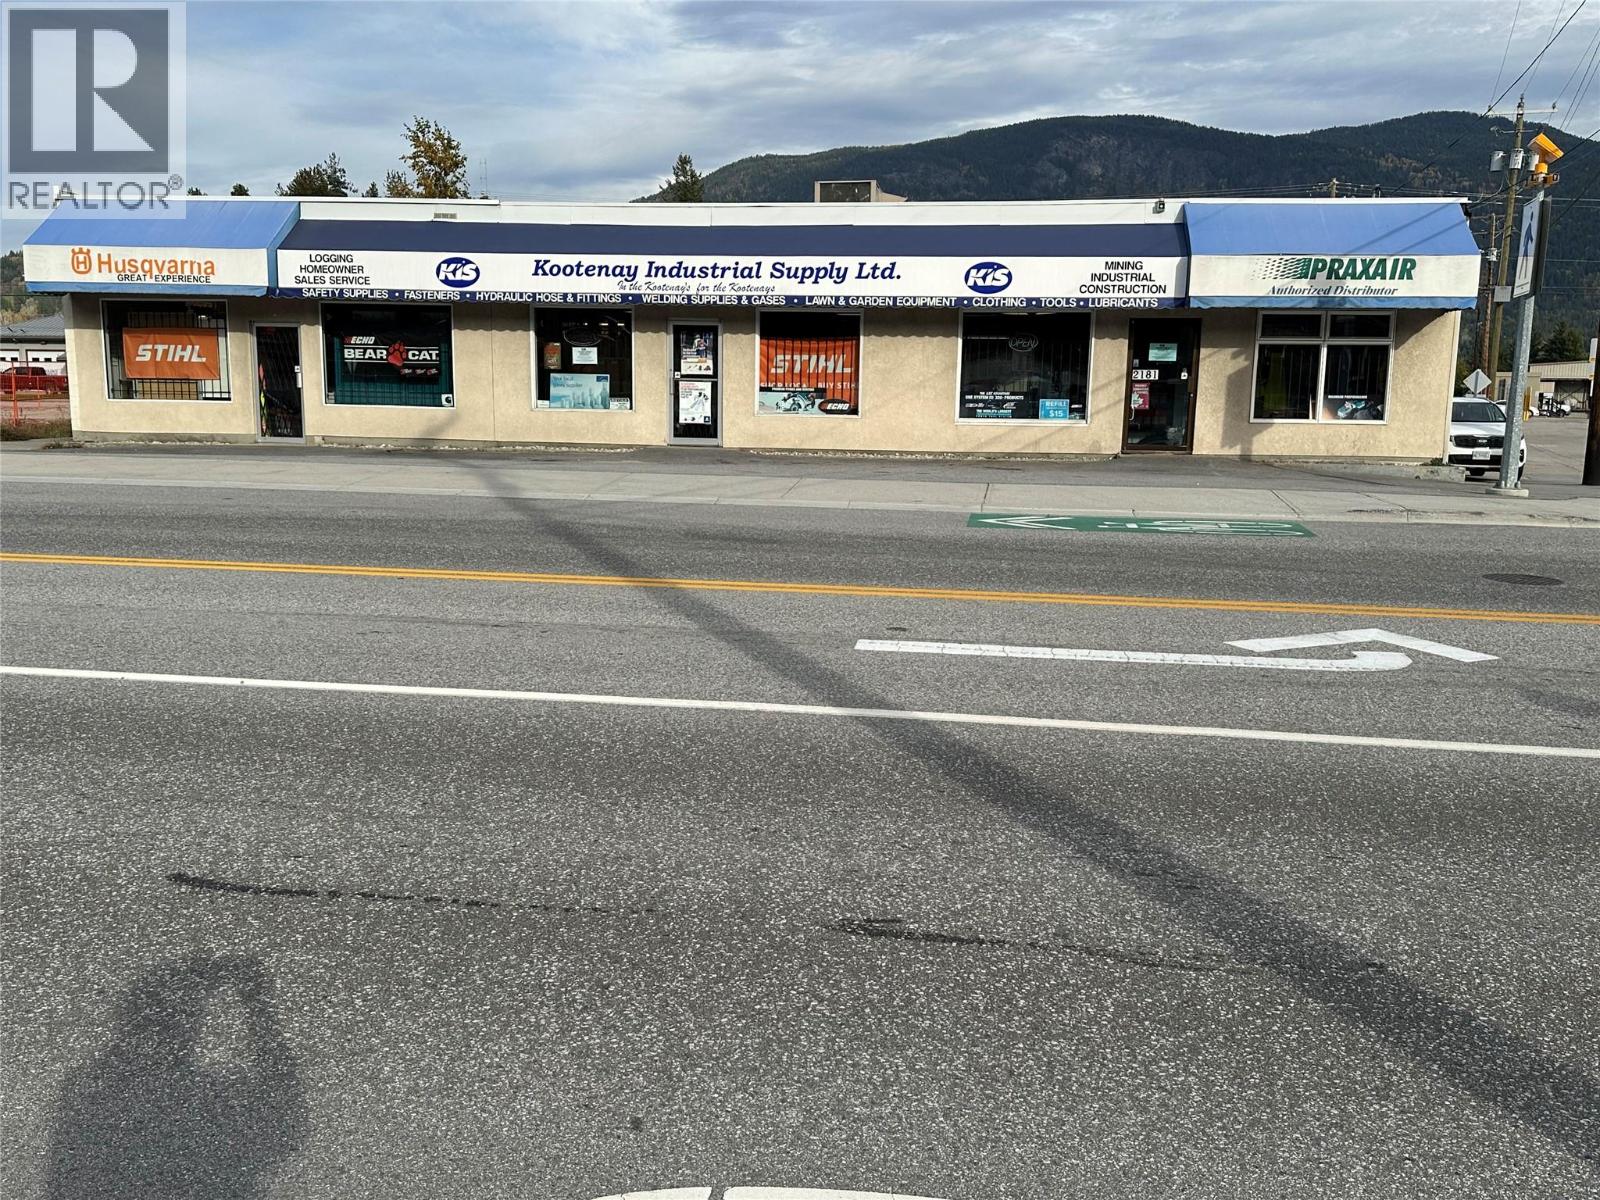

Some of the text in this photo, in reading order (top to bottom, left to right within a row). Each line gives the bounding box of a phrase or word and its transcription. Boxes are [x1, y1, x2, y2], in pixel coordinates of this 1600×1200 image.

[309, 254, 354, 263] LOGGING
[97, 253, 215, 280] Husqvarna
[299, 265, 364, 274] HOMEOWNER
[1104, 261, 1144, 270] MINING
[1310, 257, 1417, 280] PRAXAIR
[532, 259, 902, 284] Kootenay Industrial Supply Ltd.
[117, 273, 211, 284] GREAT EXPERIENCE
[294, 275, 371, 285] SALES SERVICE
[1090, 273, 1156, 282] INDUSTRIAL
[617, 280, 627, 291] In
[629, 281, 643, 291] the
[696, 282, 710, 294] for
[713, 282, 727, 292] the
[728, 282, 776, 294] Kootenays
[1079, 284, 1167, 294] CONSTRUCTION
[1267, 285, 1399, 296] Authorized Distributor
[302, 288, 1159, 308] SAFETY SUPPLIES FASTENERS HYDRAULIC HOSE & FITTINGS WELDING SUPPLIES & GASES LAWN & GARDEN EQUIPMENT CLOTHING TOOLS LUBRICANTS
[350, 336, 376, 345] ECHO
[135, 344, 207, 363] STIHL
[343, 348, 440, 360] BEAR CAT
[770, 354, 854, 374] STIHL
[1133, 370, 1157, 379] 2181
[826, 402, 850, 411] ECHO
